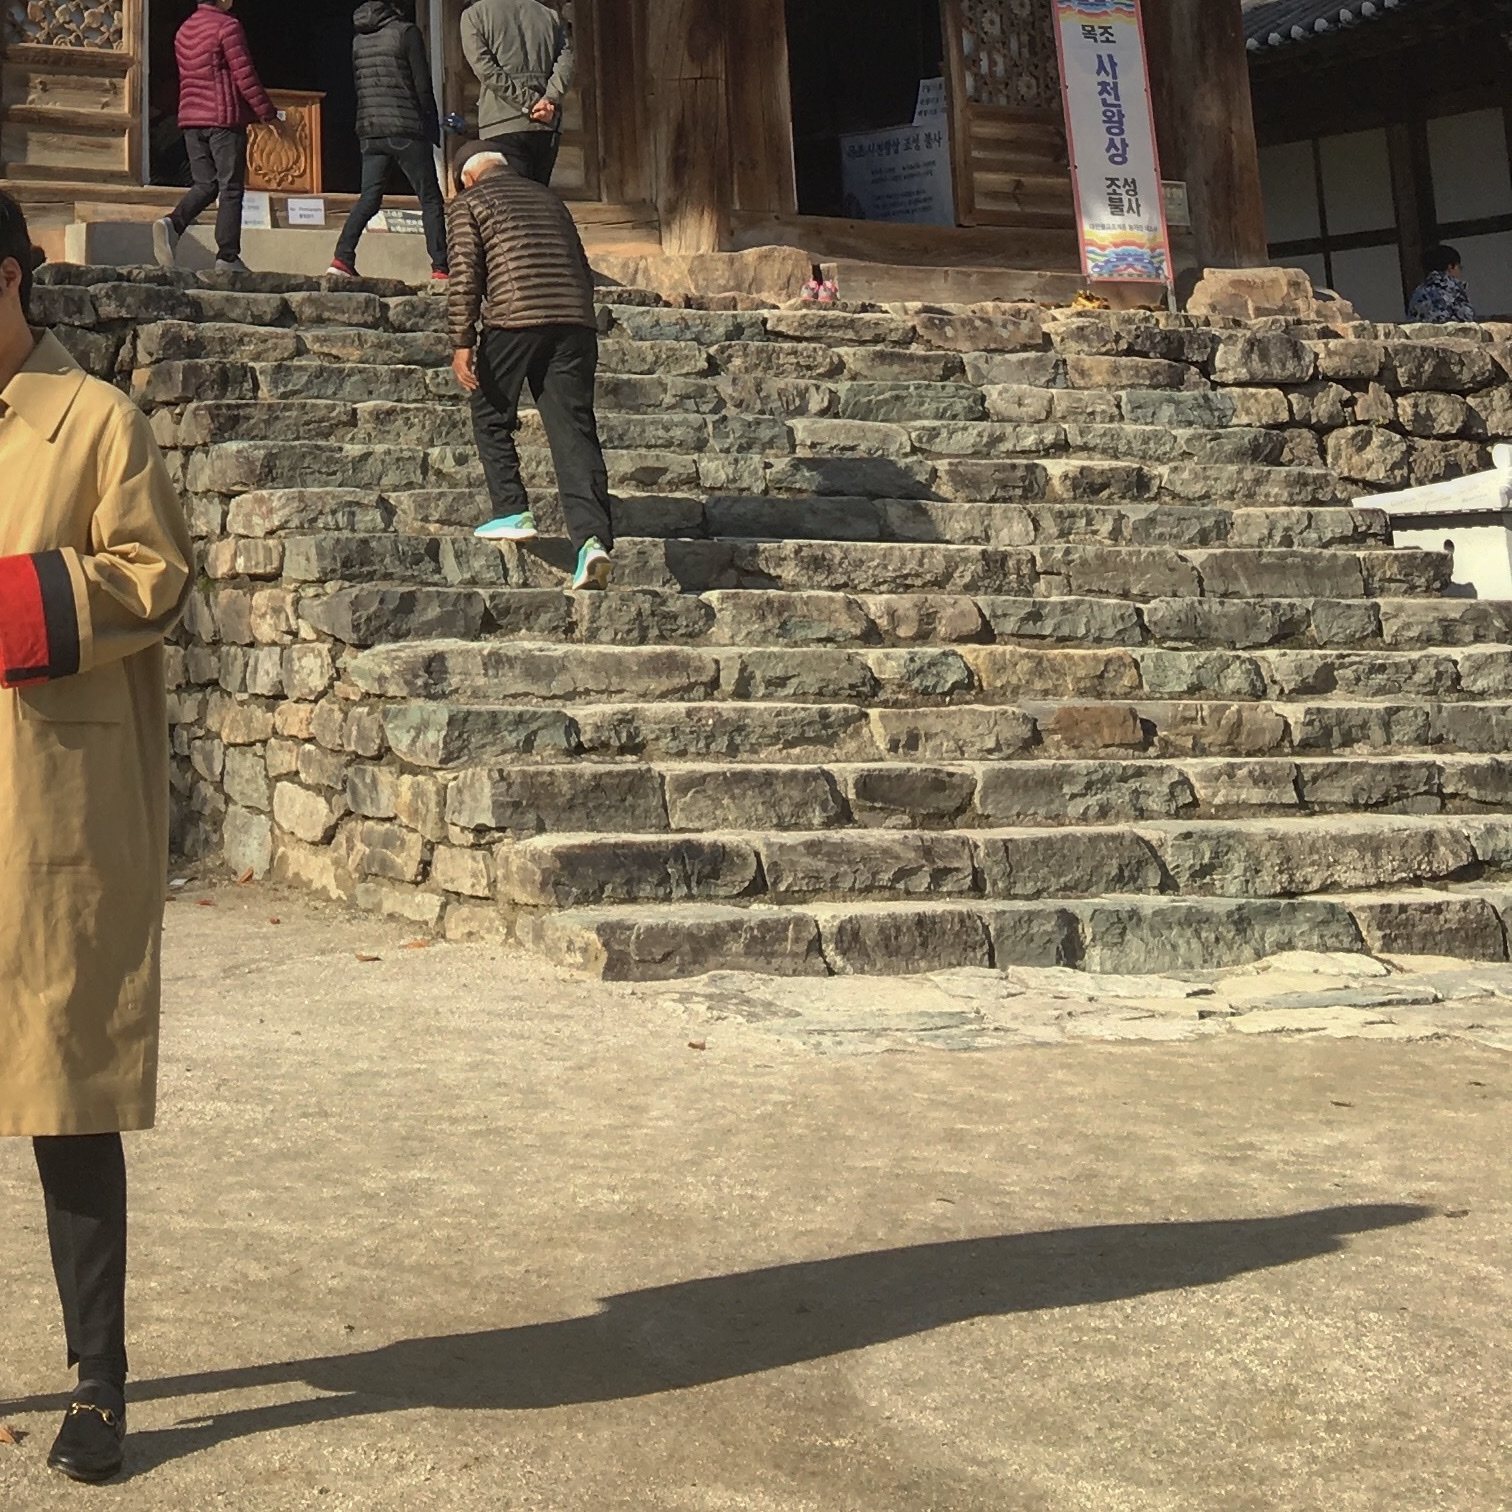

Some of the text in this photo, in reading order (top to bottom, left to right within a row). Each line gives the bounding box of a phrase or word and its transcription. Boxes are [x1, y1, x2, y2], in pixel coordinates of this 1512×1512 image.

[1081, 23, 1116, 45] 목조
[1096, 53, 1129, 166] 사천왕상
[1104, 176, 1139, 197] 조성
[1107, 196, 1142, 218] 불사
